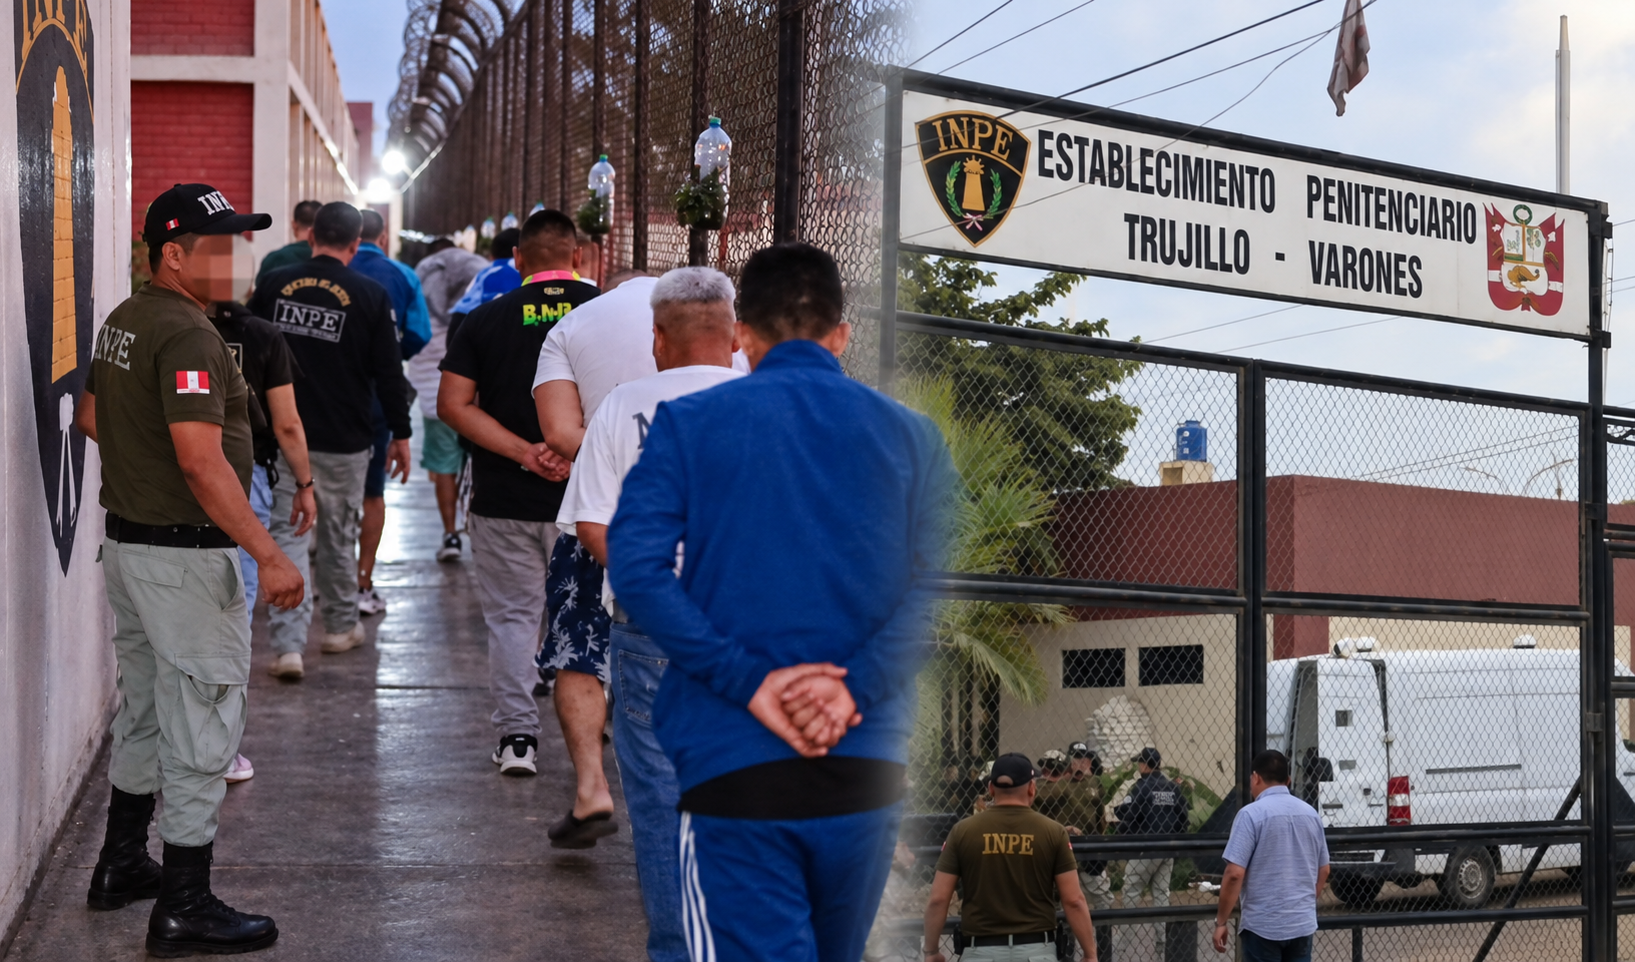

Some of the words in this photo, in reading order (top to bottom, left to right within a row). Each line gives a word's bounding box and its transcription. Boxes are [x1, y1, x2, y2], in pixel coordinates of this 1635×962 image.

[932, 117, 1013, 160] INPE
[1038, 129, 1276, 214] ESTABLECIMIENTO
[1306, 174, 1477, 245] PENITENCIARIO
[1124, 213, 1250, 275] TRUJILLO
[1308, 240, 1423, 299] VARONES
[280, 304, 339, 332] INPE
[982, 833, 1034, 855] INPE
